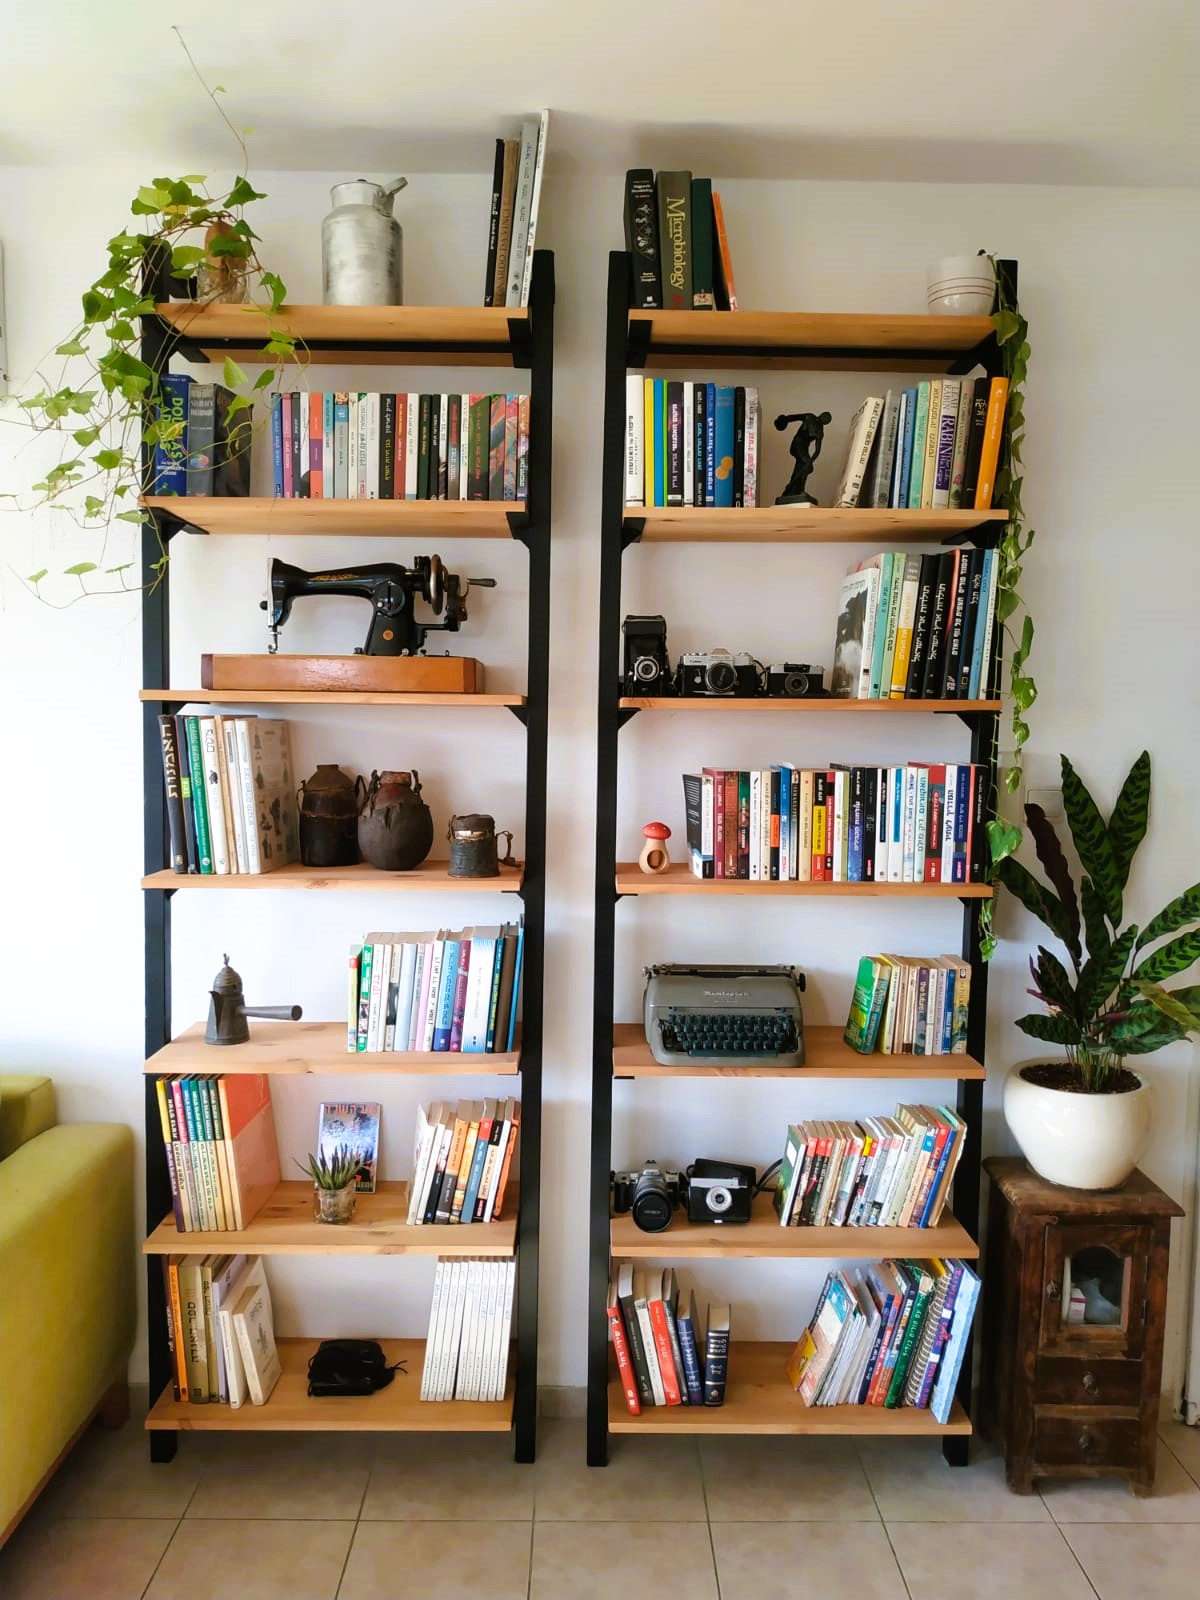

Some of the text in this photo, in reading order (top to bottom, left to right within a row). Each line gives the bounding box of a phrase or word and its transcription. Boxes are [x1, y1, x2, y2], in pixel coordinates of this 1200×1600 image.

[666, 196, 686, 289] Microbiology
[951, 386, 959, 409] LEAH
[939, 417, 955, 454] RABIN
[960, 554, 968, 574] דסמונד
[935, 583, 946, 611] תולדות
[959, 576, 967, 593] מוריס
[970, 574, 981, 604] פלאי תבל
[919, 585, 930, 613] תולדות
[951, 639, 959, 655] האדם
[204, 728, 215, 752] צילום
[161, 724, 179, 798] האמנות
[919, 777, 927, 814] האקווריום
[917, 819, 926, 830] דיק
[187, 1302, 197, 1322] ספר
[614, 1331, 628, 1367] שירי רחל
